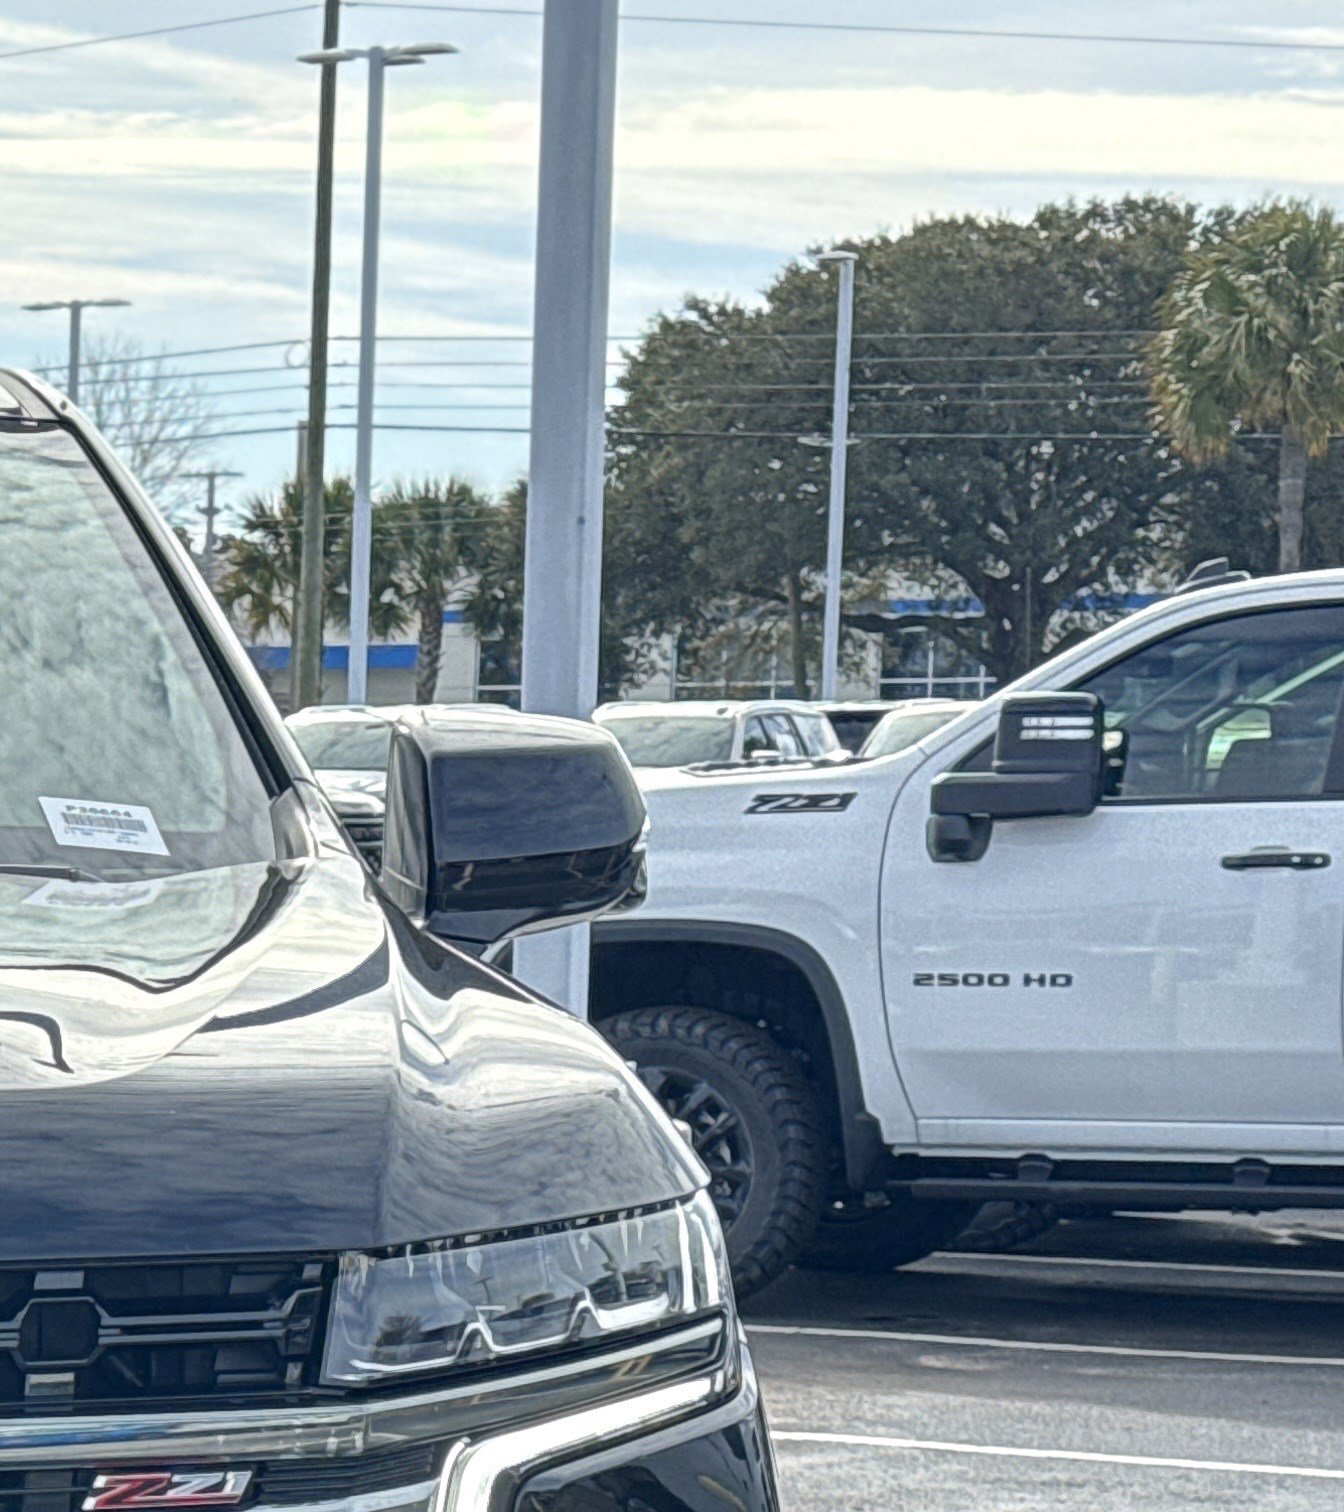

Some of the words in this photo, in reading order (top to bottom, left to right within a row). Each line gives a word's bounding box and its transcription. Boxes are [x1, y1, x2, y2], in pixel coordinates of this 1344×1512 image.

[743, 791, 859, 815] Z71
[912, 972, 1011, 988] 2500
[1022, 972, 1074, 988] HD
[81, 1469, 253, 1511] Z71
